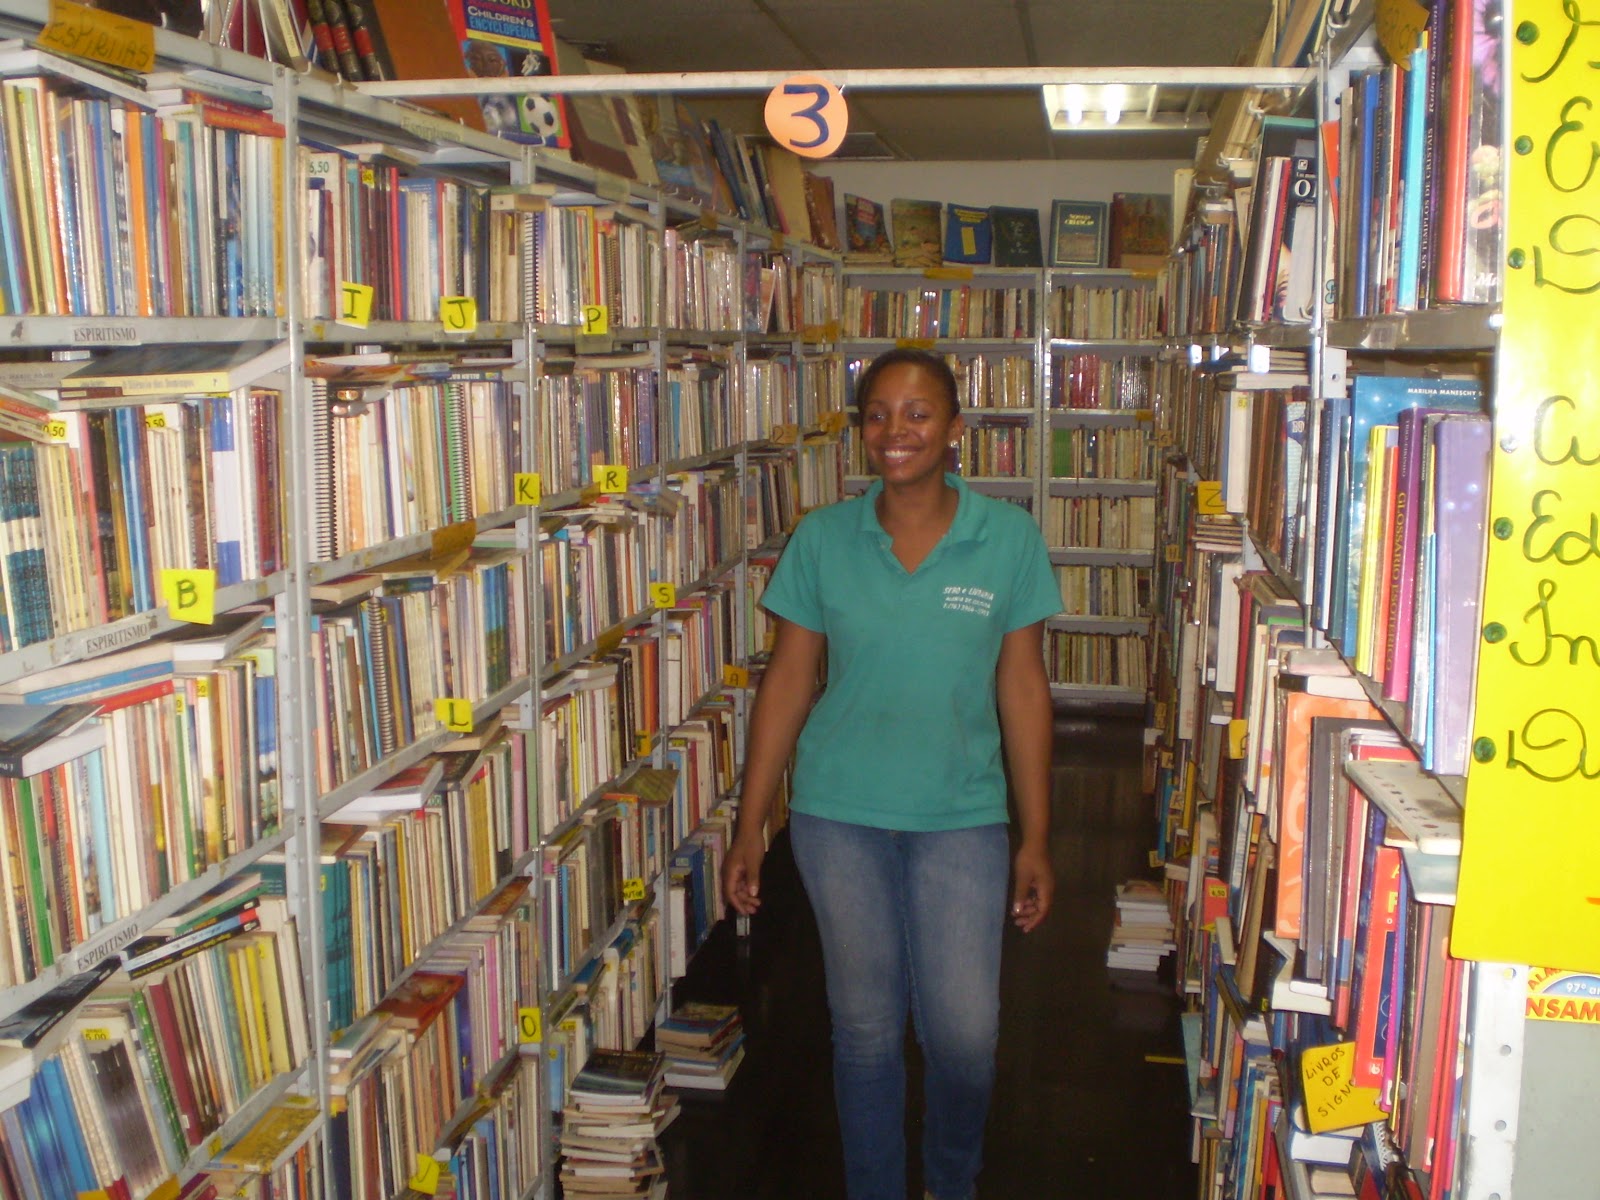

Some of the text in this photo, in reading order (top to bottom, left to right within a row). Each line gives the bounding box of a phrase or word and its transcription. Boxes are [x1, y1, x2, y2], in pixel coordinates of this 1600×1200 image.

[782, 83, 831, 149] 3
[446, 299, 470, 329] J
[586, 307, 601, 332] P
[73, 326, 137, 342] ESPIRITISMO
[518, 478, 534, 500] K
[605, 470, 620, 488] R
[176, 579, 199, 610] B
[658, 587, 671, 603] S
[85, 622, 148, 654] ESPIRITISMO
[449, 701, 469, 727] L
[77, 922, 139, 971] ESPIRITISMO
[1305, 1046, 1346, 1081] LIVROS
[1321, 1066, 1341, 1087] DE
